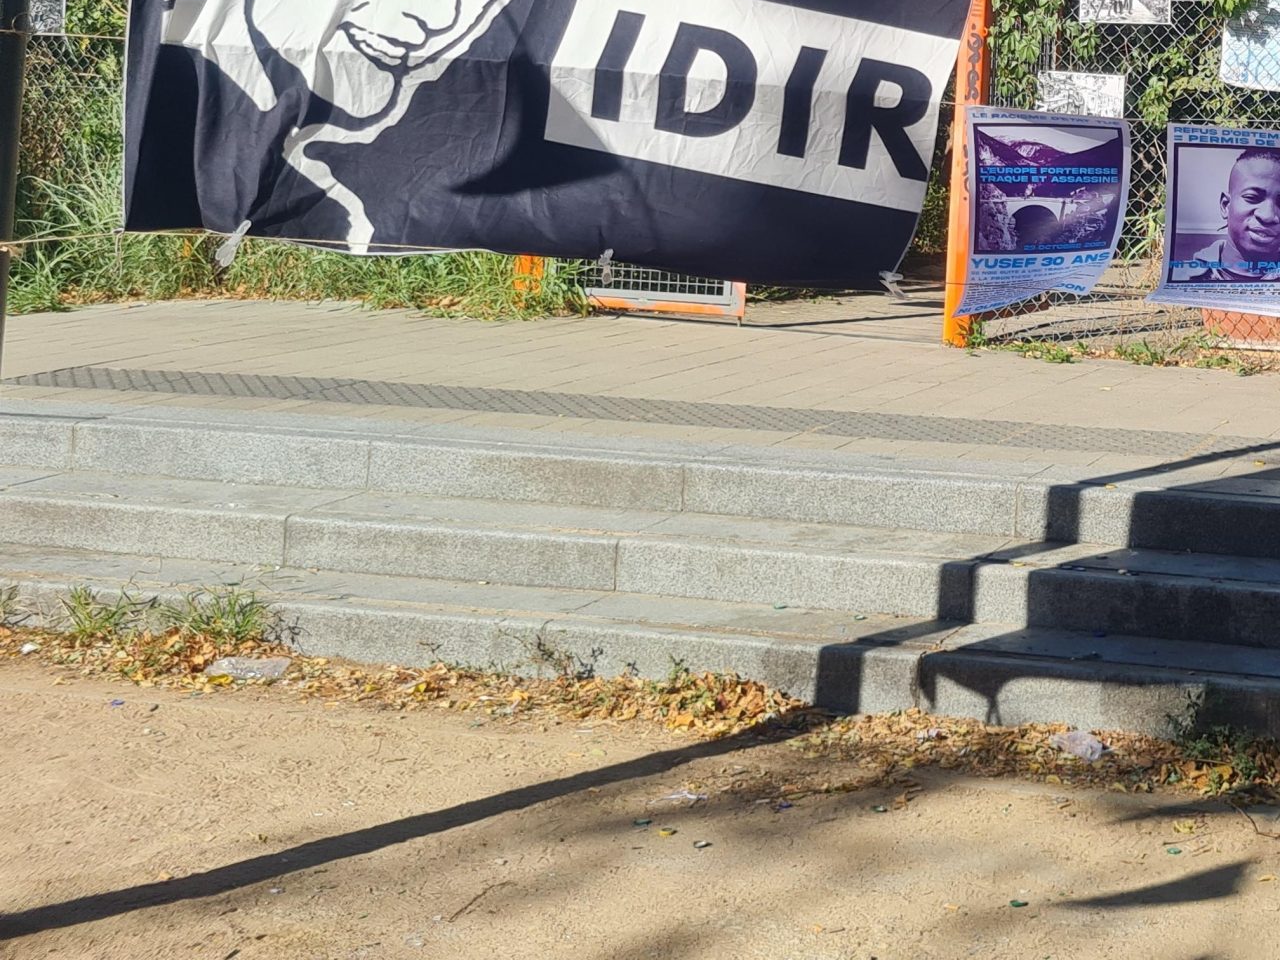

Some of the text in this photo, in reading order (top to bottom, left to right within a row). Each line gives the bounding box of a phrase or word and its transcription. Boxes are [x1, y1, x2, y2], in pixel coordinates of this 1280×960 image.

[591, 10, 933, 183] IDIR
[1174, 126, 1218, 136] REFUS
[1188, 134, 1250, 145] PERMIS
[1255, 138, 1276, 147] DE
[980, 167, 1118, 175] L'EUROPE FORTERESSE
[980, 175, 1119, 183] TRAQUE ET ASSASSINE
[971, 251, 1111, 269] YUSEF 30 ANS
